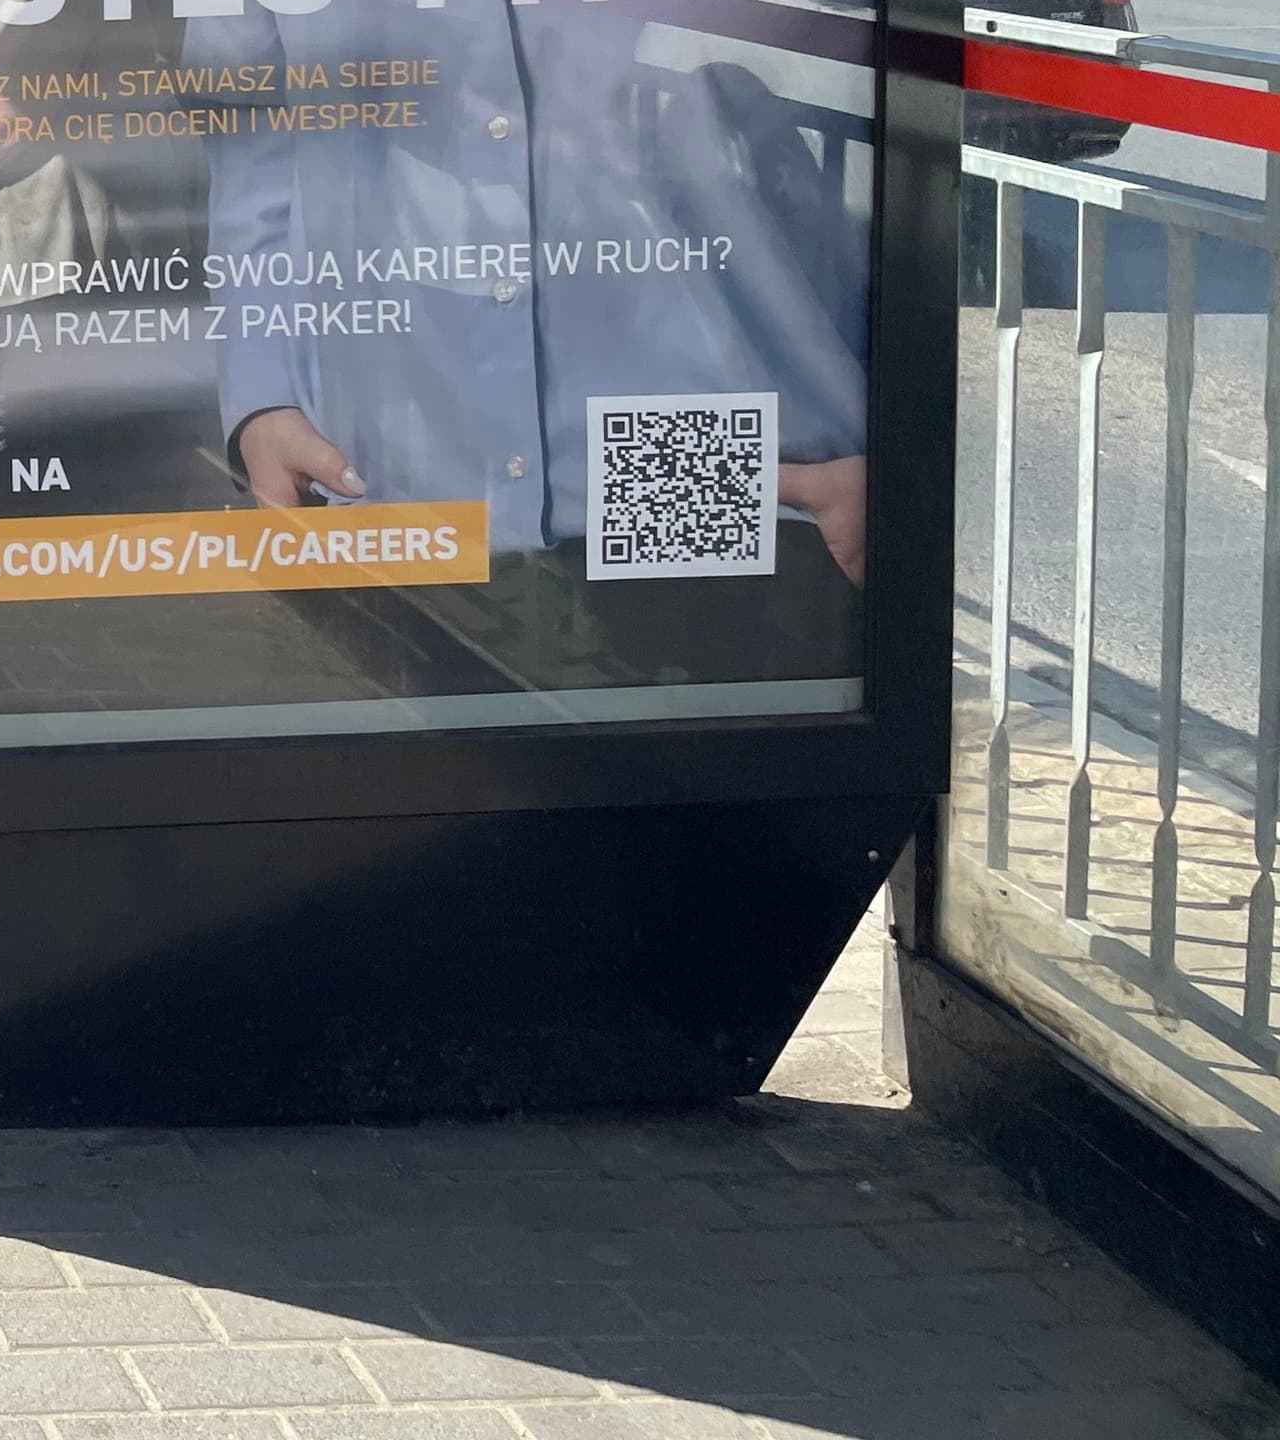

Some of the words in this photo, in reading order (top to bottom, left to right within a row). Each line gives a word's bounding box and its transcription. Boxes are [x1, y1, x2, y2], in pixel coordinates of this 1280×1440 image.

[22, 71, 107, 101] NAMI,
[118, 65, 276, 97] STAWIASZ
[285, 62, 329, 89] NA
[339, 59, 441, 88] SIEBIE
[65, 113, 114, 144] CIĘ
[125, 108, 238, 138] DOCENI
[250, 107, 257, 134] I
[267, 101, 428, 132] WESPRZE.
[202, 250, 344, 291] SWOJĄ
[356, 242, 532, 284] KARIERĘ
[542, 241, 584, 276] W
[596, 235, 734, 274] RUCH?
[55, 306, 190, 346] RAZEM
[204, 305, 227, 340] Z
[241, 298, 413, 341] PARKER!
[12, 457, 71, 492] NA
